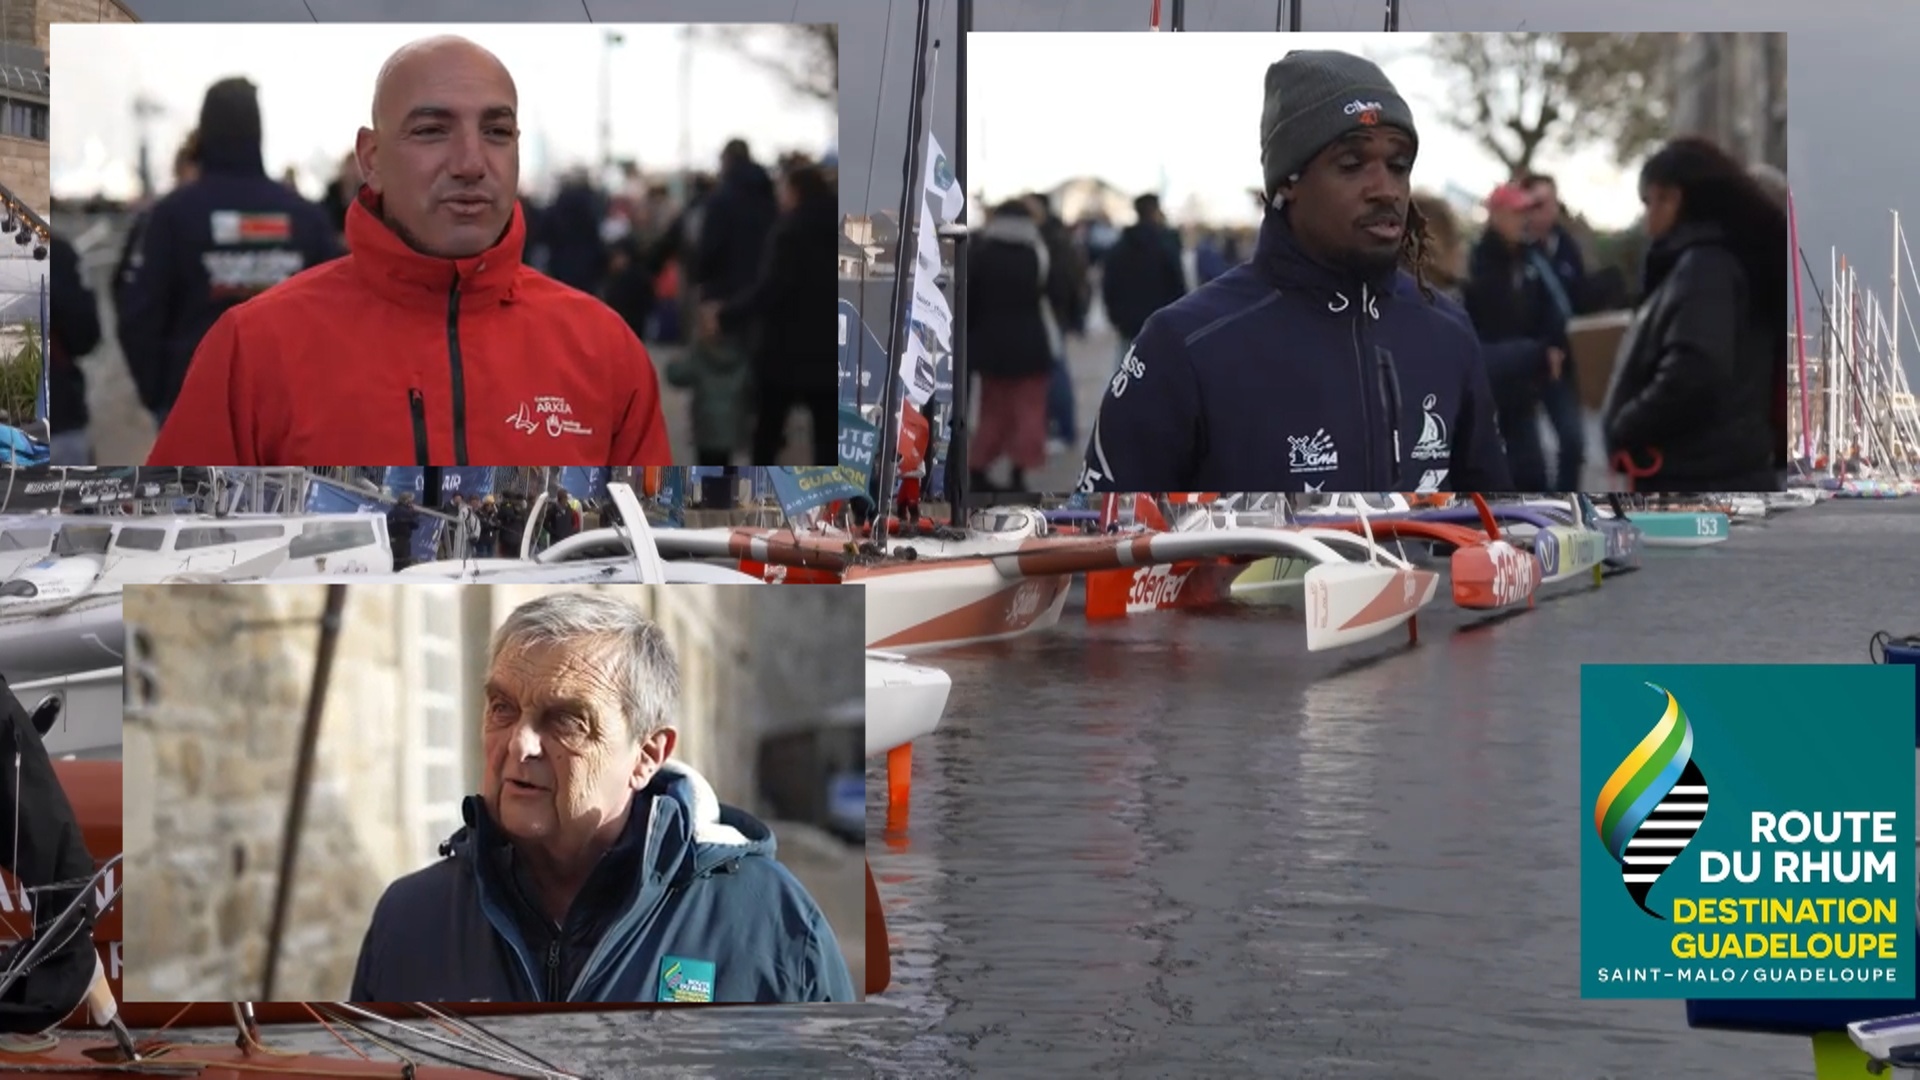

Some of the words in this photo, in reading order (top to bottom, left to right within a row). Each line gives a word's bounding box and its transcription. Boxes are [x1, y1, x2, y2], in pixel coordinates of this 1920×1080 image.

[838, 427, 875, 447] UTE
[838, 443, 872, 465] UM
[1307, 451, 1338, 466] GMA
[1695, 517, 1718, 536] 153
